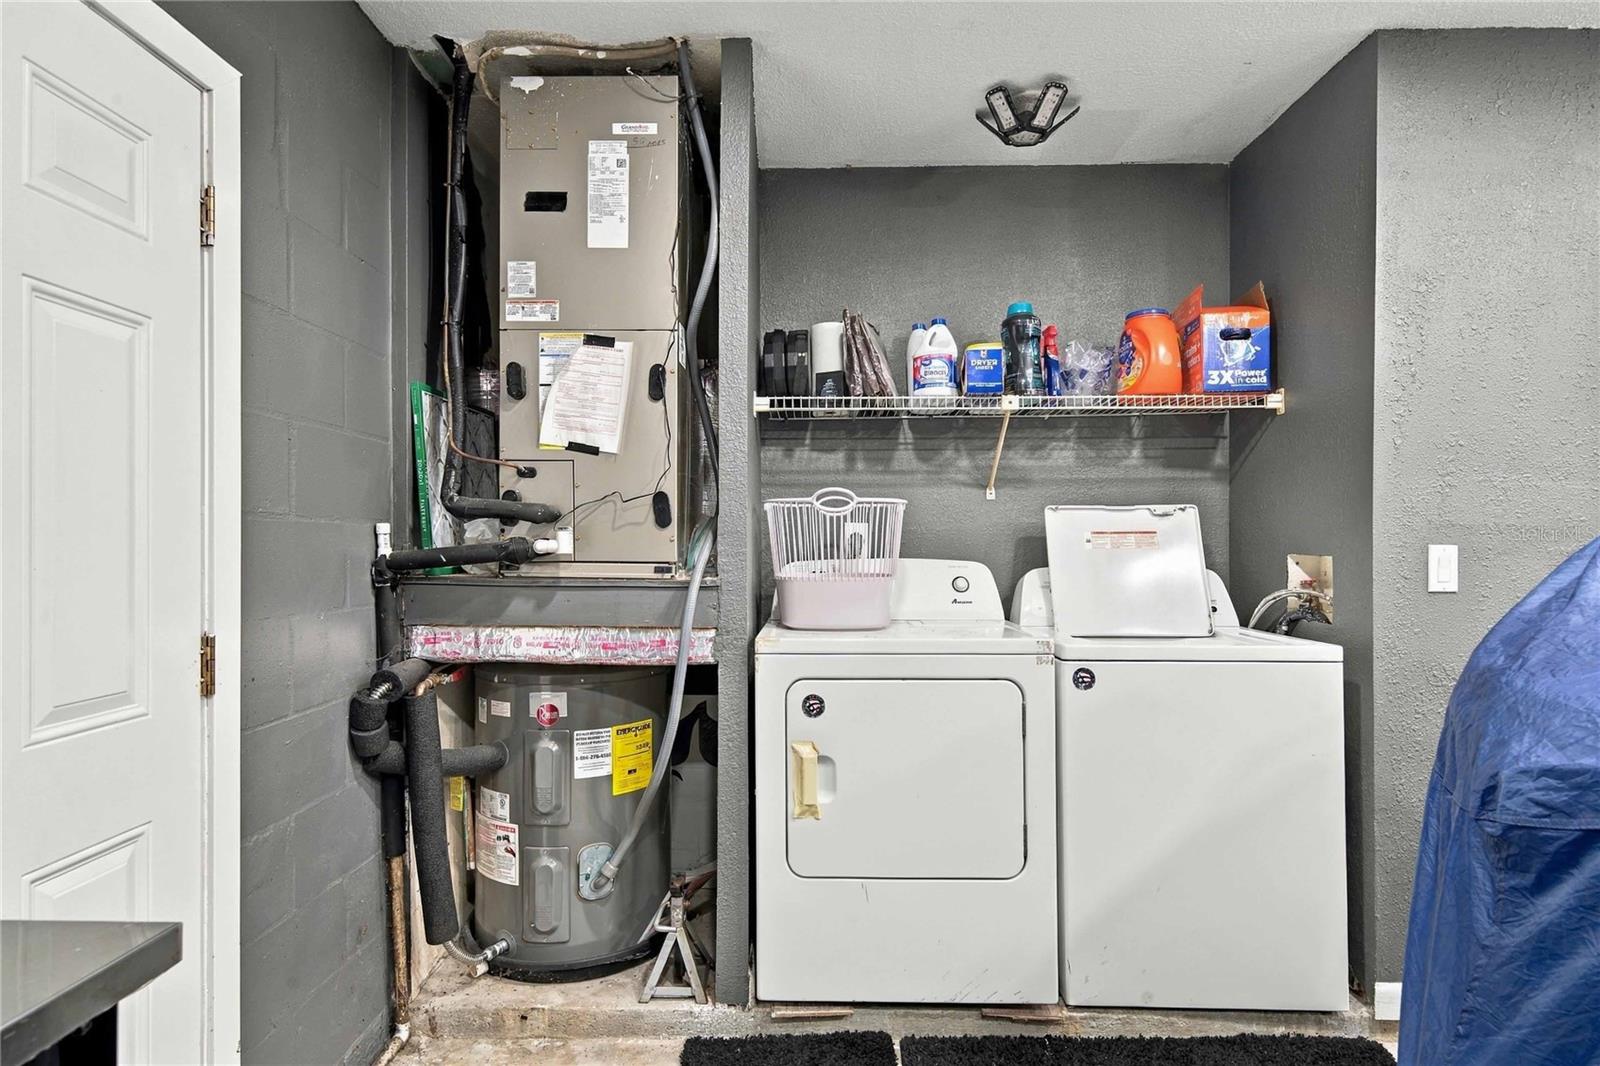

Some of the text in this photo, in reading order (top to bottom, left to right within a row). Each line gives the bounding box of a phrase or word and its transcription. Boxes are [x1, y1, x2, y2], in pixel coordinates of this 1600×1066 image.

[1208, 370, 1235, 384] 3X
[1235, 369, 1267, 377] Power
[1245, 376, 1267, 384] cold
